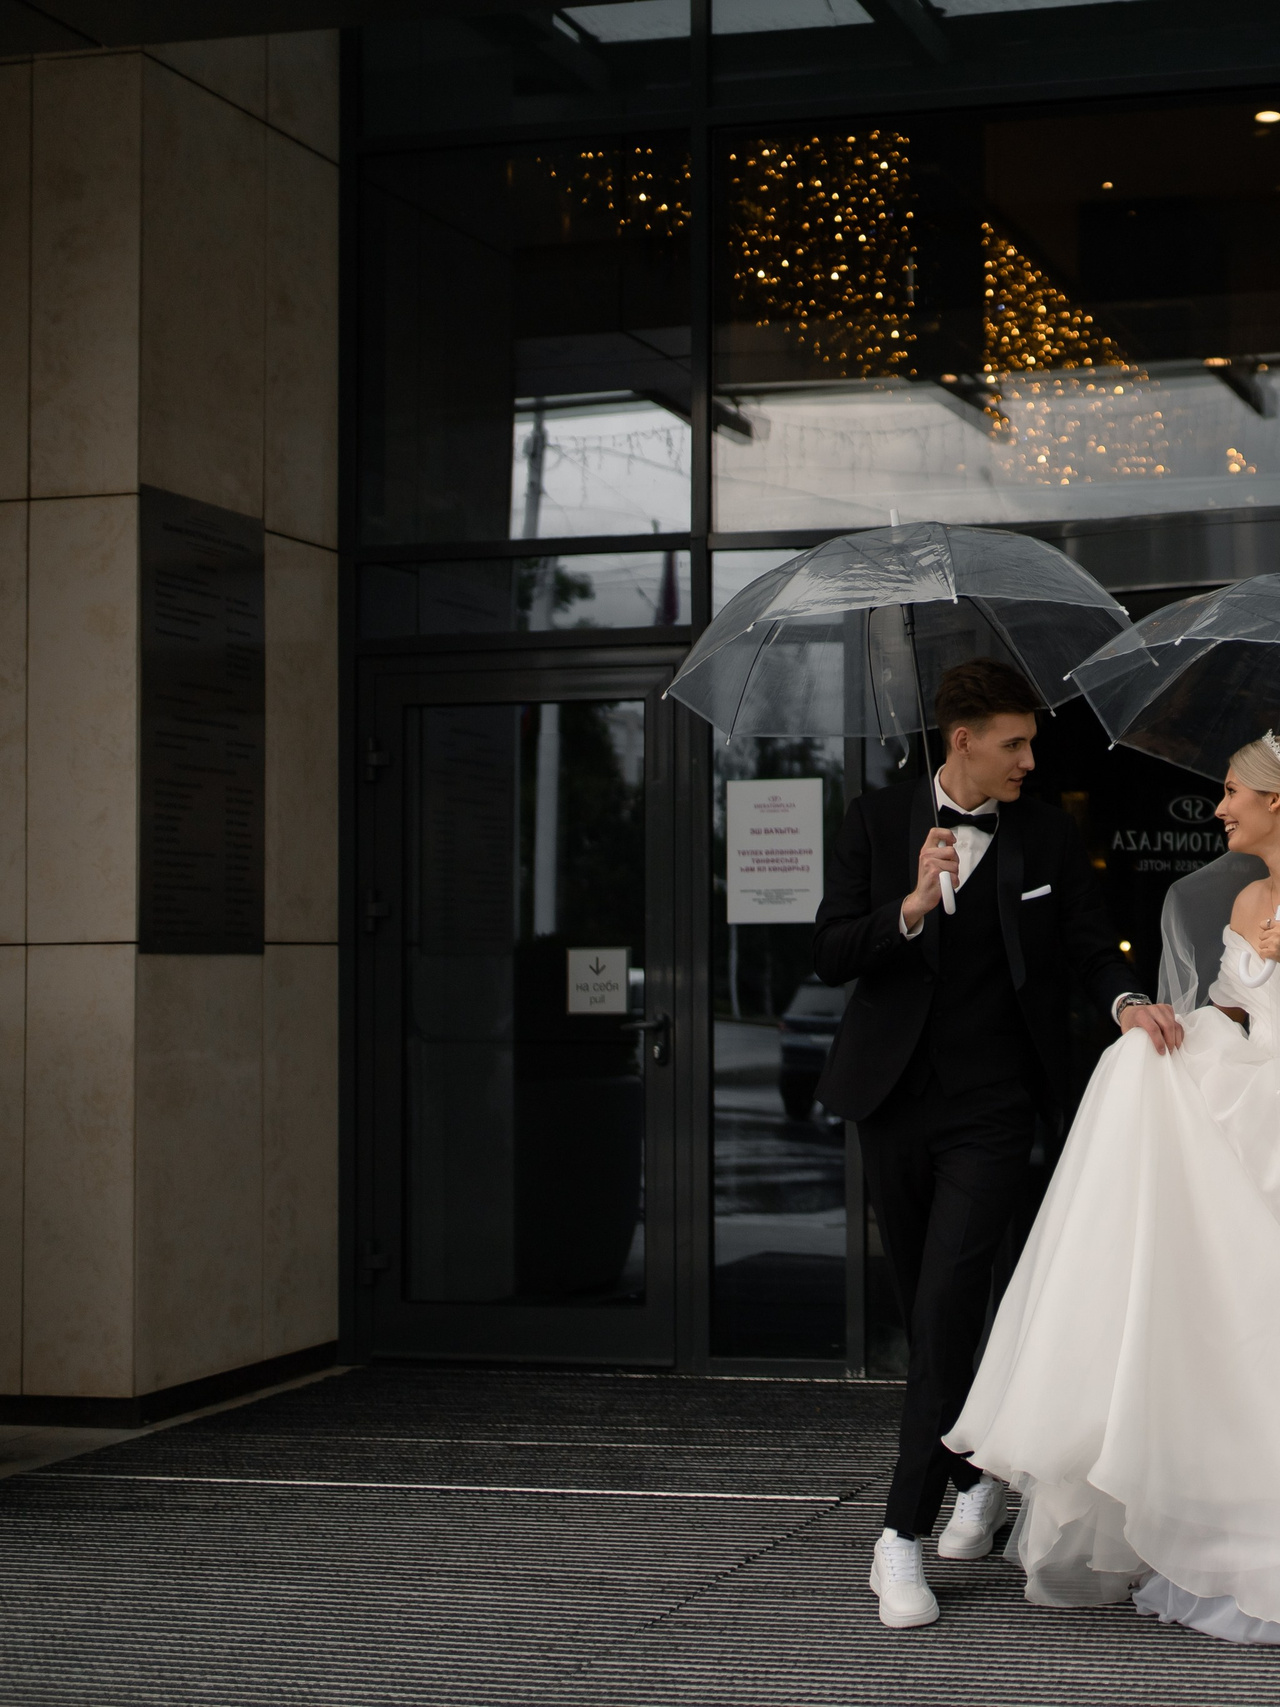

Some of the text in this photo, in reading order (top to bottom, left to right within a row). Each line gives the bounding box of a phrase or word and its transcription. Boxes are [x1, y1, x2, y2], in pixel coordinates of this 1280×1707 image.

[576, 980, 619, 992] на себя
[589, 995, 606, 1006] pull
